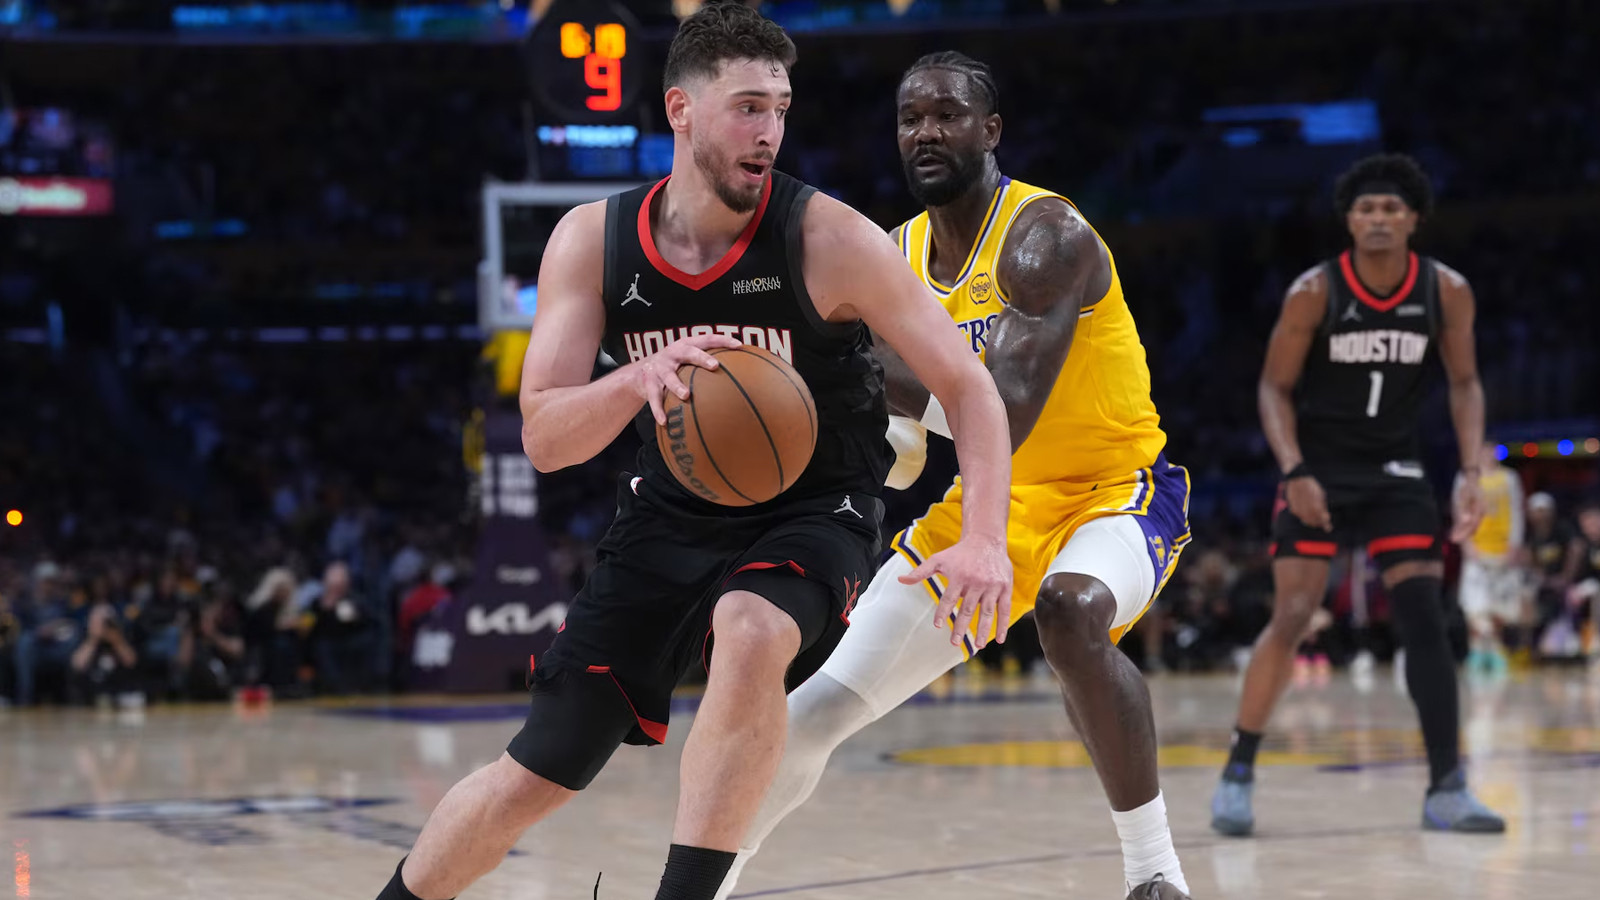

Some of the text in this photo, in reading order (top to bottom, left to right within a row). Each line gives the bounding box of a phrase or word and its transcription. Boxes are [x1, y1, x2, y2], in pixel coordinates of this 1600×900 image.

[584, 53, 622, 111] 9
[732, 276, 781, 288] MEMORIAL
[733, 282, 781, 294] HERMANN
[624, 324, 793, 367] HOON
[1329, 329, 1429, 365] HOUSTON
[1366, 371, 1384, 418] 1
